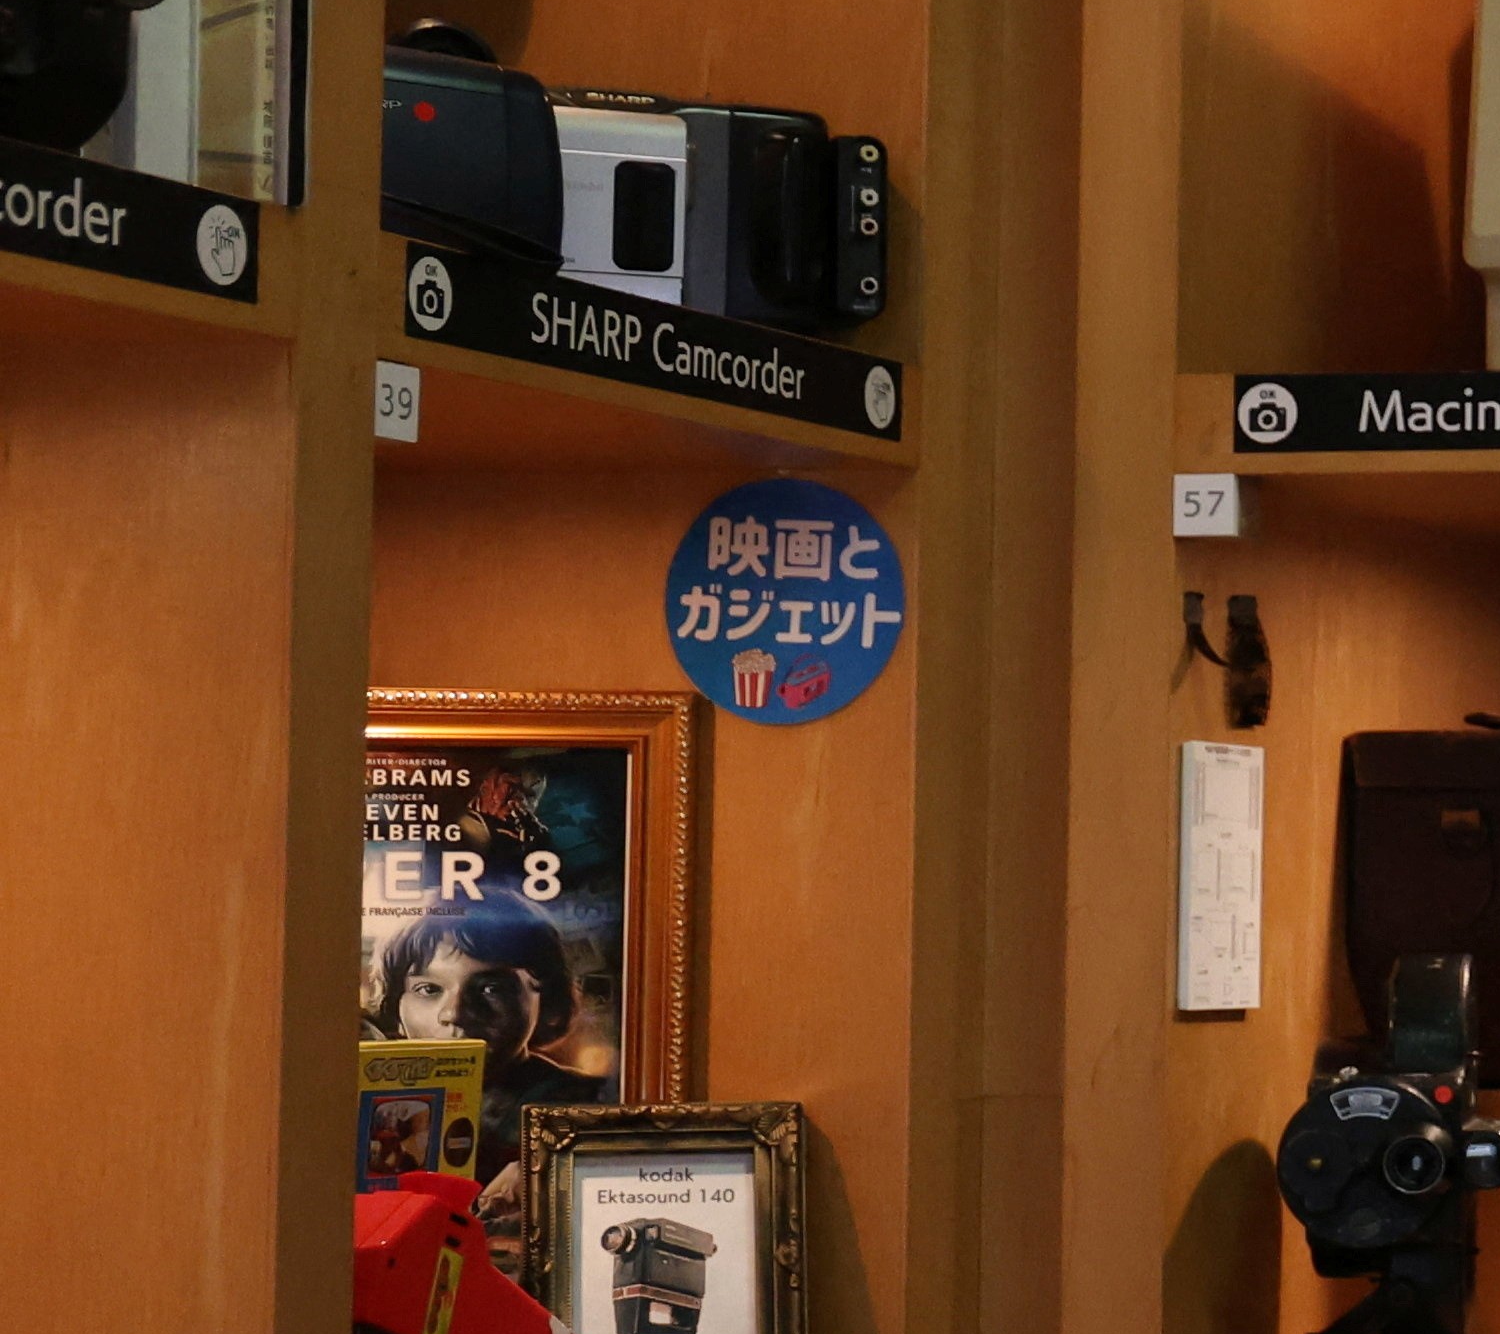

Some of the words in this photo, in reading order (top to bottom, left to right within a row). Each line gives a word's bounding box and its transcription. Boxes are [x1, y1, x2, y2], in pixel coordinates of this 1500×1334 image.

[585, 91, 657, 105] SHARP
[0, 176, 127, 252] corder
[530, 292, 643, 362] SHARP
[652, 322, 806, 401] Camcorder
[378, 383, 413, 420] 39
[1183, 490, 1226, 520] 57
[707, 515, 882, 582] 映画と
[676, 583, 902, 649] ガジェット
[366, 768, 472, 787] BRAMS
[522, 850, 563, 902] 8
[369, 906, 424, 919] FRANÇAISE
[638, 1168, 695, 1182] kodak
[597, 1188, 691, 1204] Ektasound
[700, 1188, 736, 1203] 140
